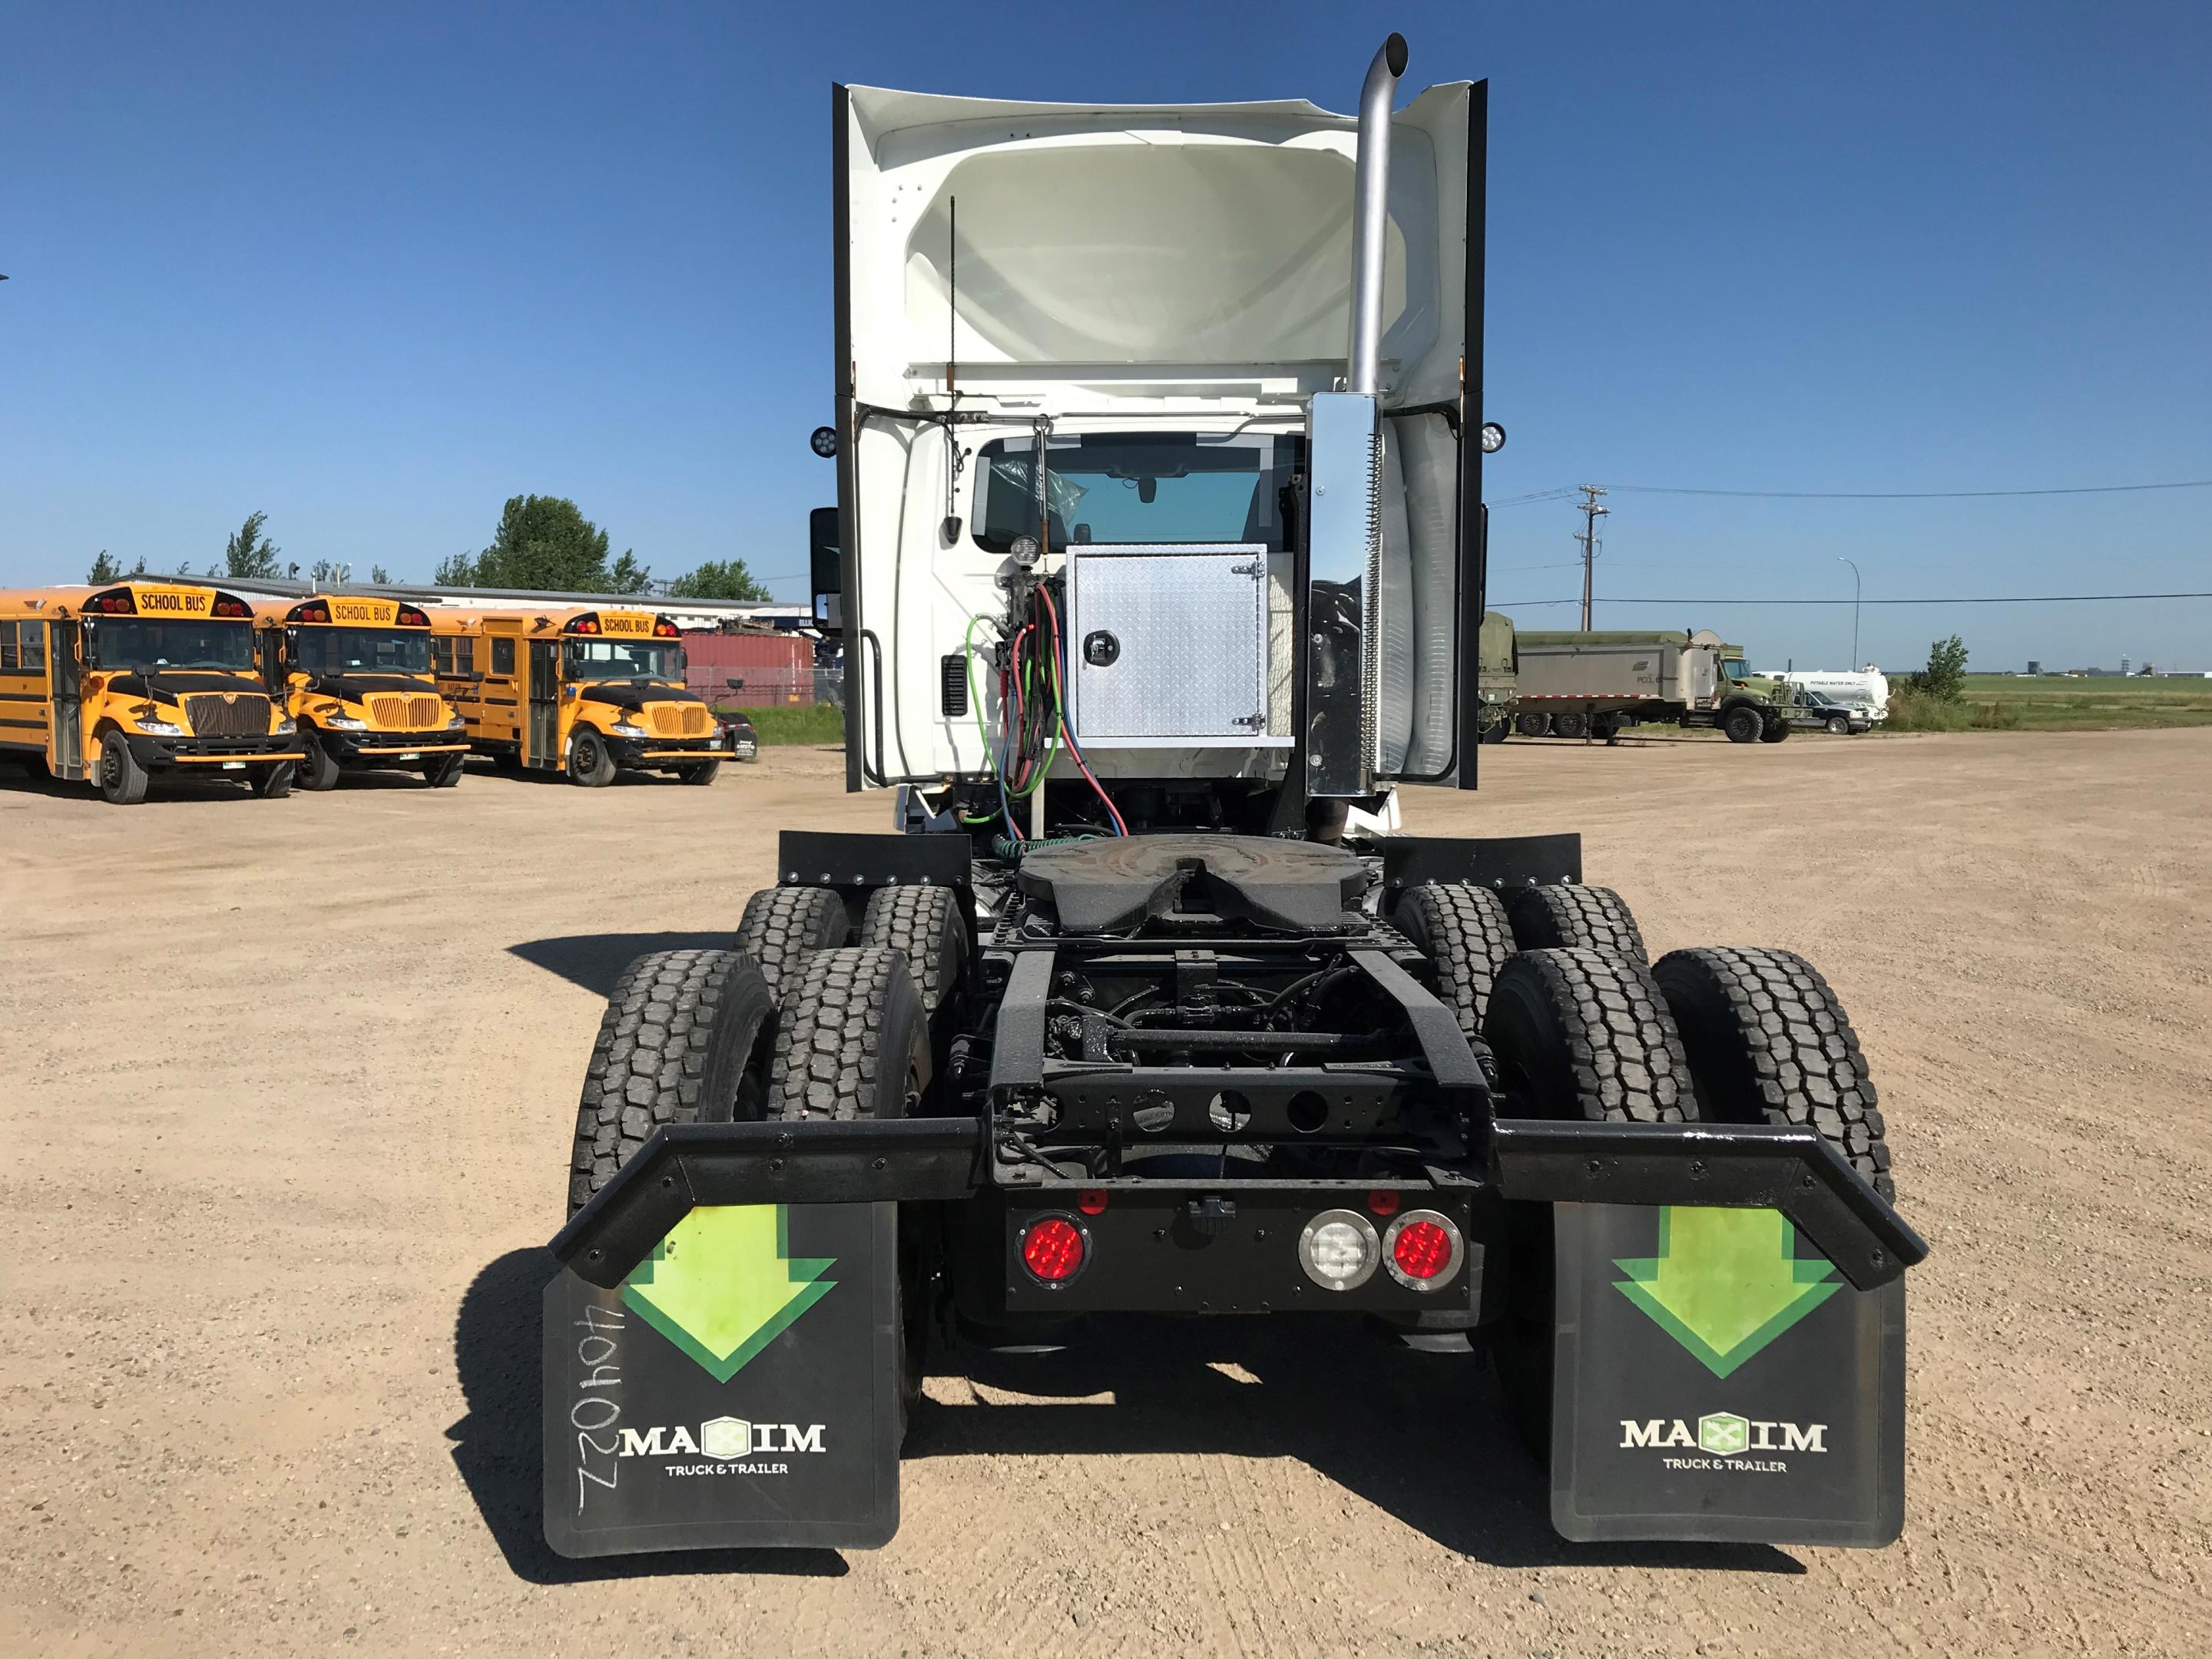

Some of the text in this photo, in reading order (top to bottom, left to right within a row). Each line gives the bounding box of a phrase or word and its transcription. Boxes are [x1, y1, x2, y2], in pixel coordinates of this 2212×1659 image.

[141, 594, 206, 611] SCHOOL BUS
[336, 605, 391, 621] SCHOOL BUS
[604, 618, 650, 633] SCHOOL BUS
[618, 1416, 826, 1460] MAXIM
[1619, 1412, 1828, 1456] MAXIM
[665, 1464, 788, 1476] TRUCK & TRAILER
[1663, 1459, 1787, 1472] TRUCK & TRAILER
